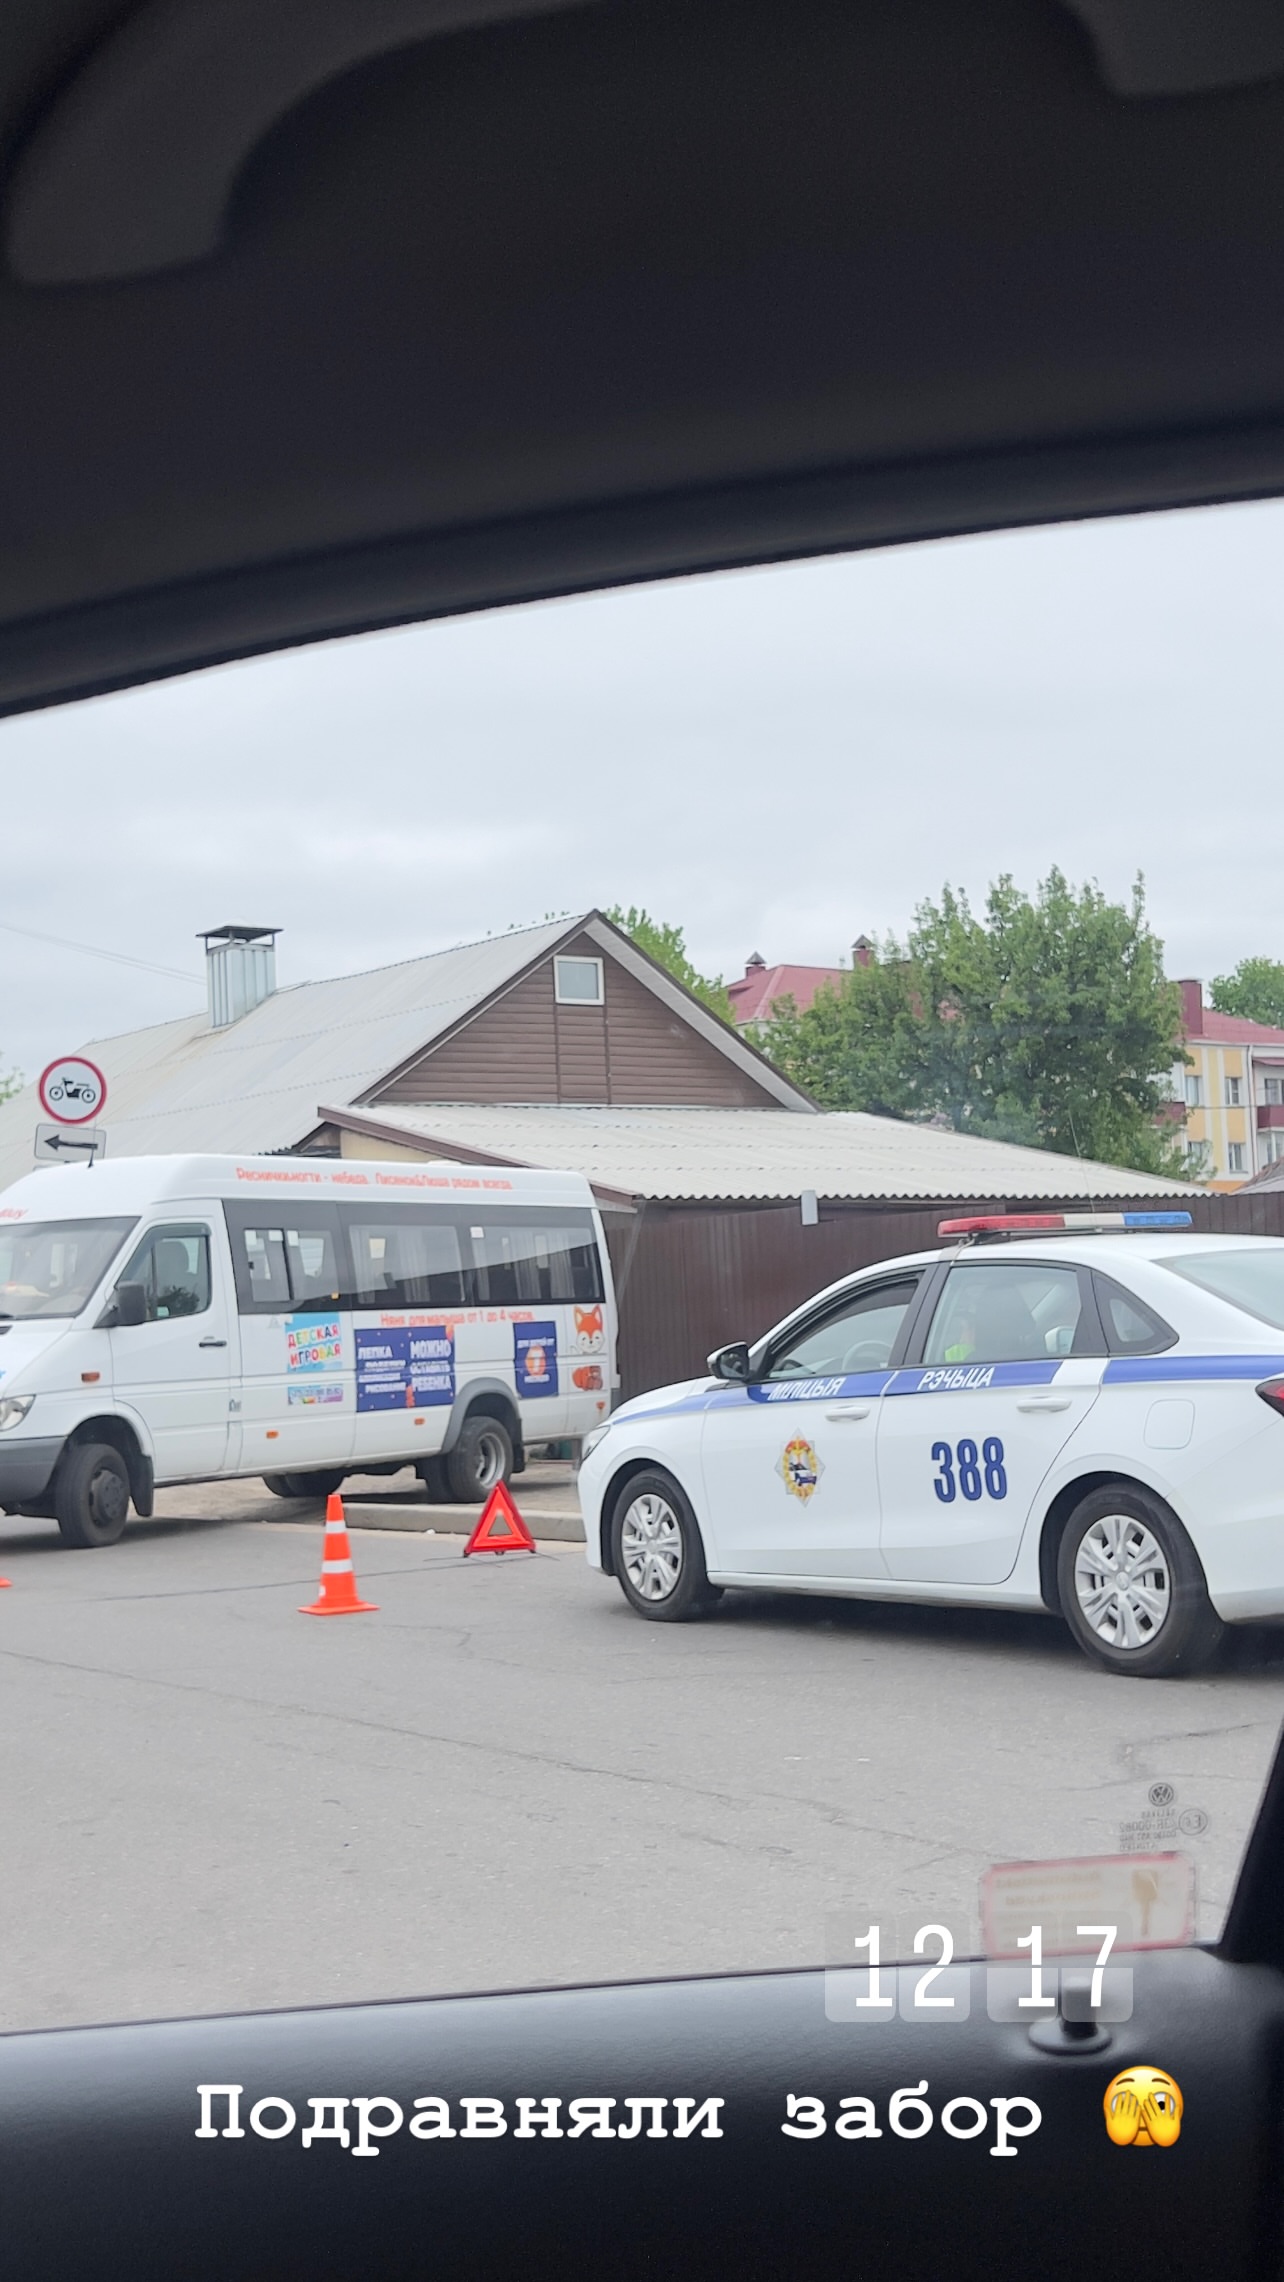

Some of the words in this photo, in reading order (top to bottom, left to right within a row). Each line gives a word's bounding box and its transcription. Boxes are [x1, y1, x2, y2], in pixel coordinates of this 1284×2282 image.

[287, 1324, 339, 1348] ДЕТСКАЯ
[289, 1343, 341, 1368] ИГРОВАЯ
[410, 1339, 452, 1360] МОЖНО
[917, 1367, 995, 1391] РЭЧЫЦА
[931, 1437, 1008, 1503] 388
